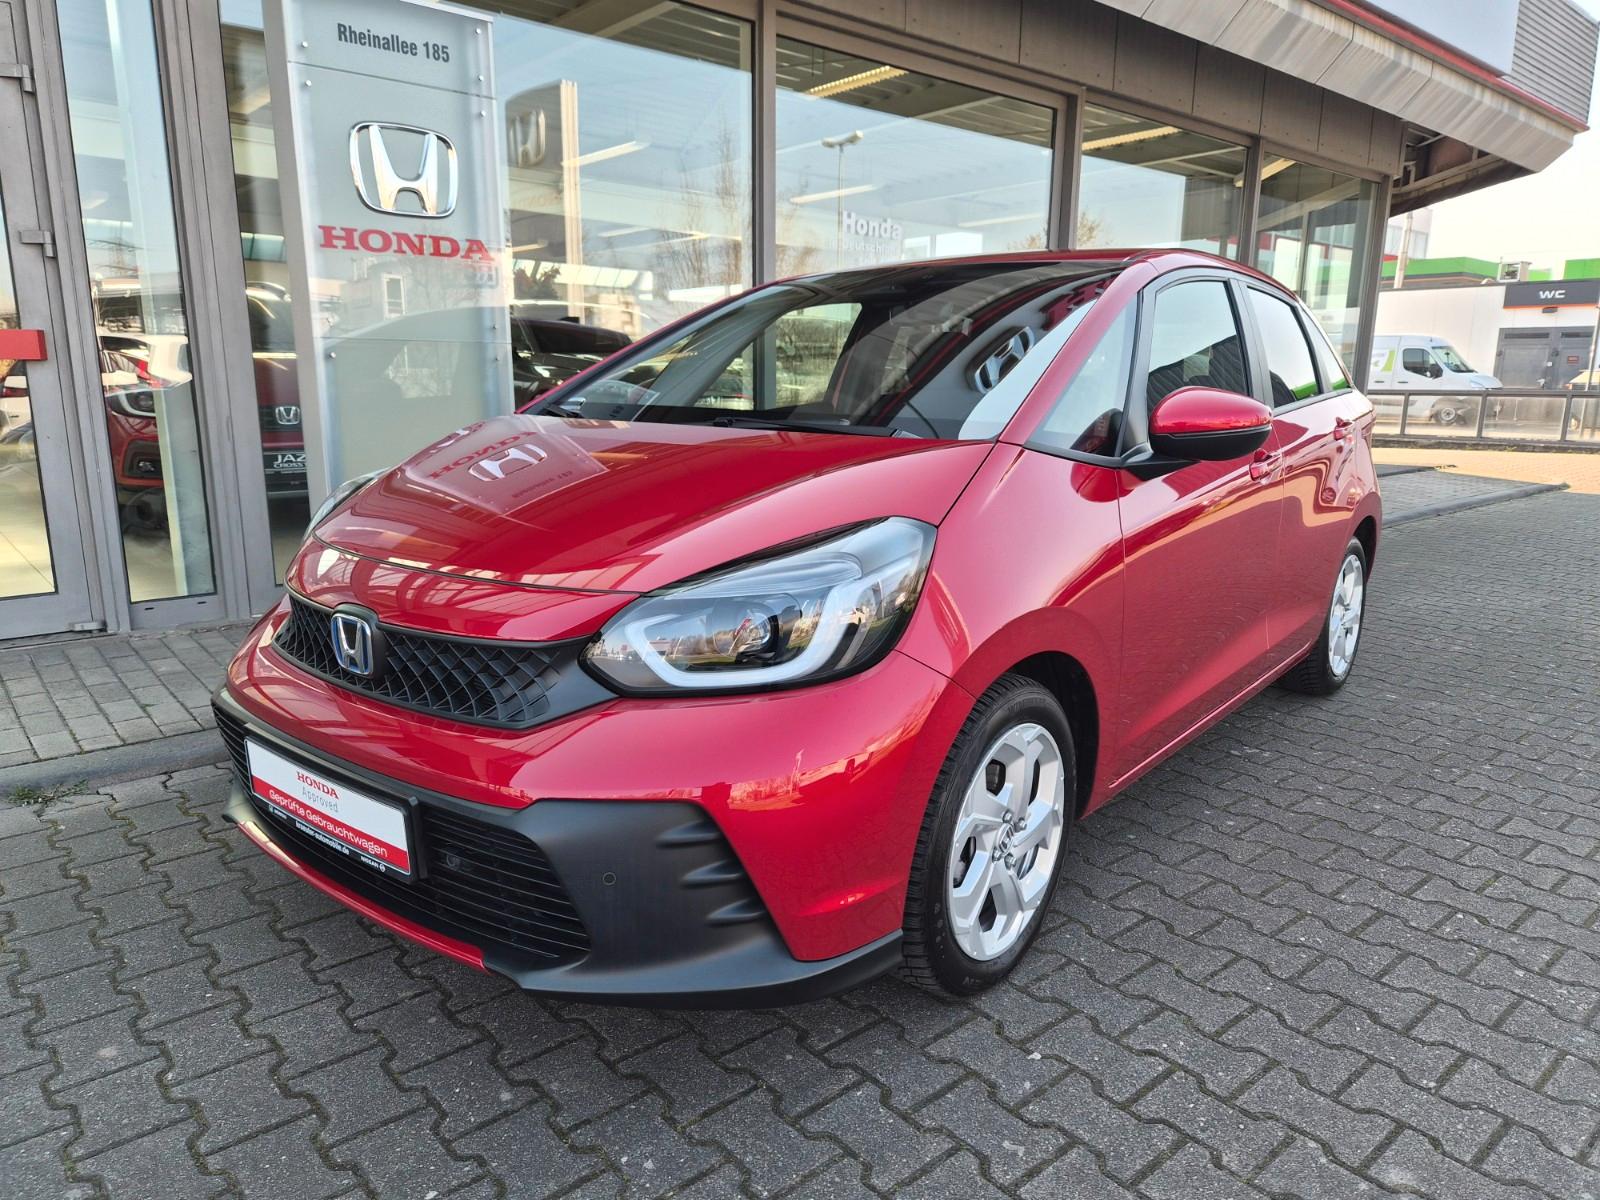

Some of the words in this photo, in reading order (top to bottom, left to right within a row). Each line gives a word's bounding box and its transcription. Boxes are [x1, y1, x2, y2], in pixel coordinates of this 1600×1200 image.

[337, 23, 418, 56] Rheinallee
[423, 41, 450, 63] 185
[842, 210, 904, 241] Honda
[318, 225, 495, 262] HONDA
[1539, 290, 1566, 299] WC
[296, 771, 340, 800] HONDA
[302, 786, 339, 813] Approved
[269, 789, 305, 816] Geprüfte
[306, 810, 388, 858] Gebrauchtwagen
